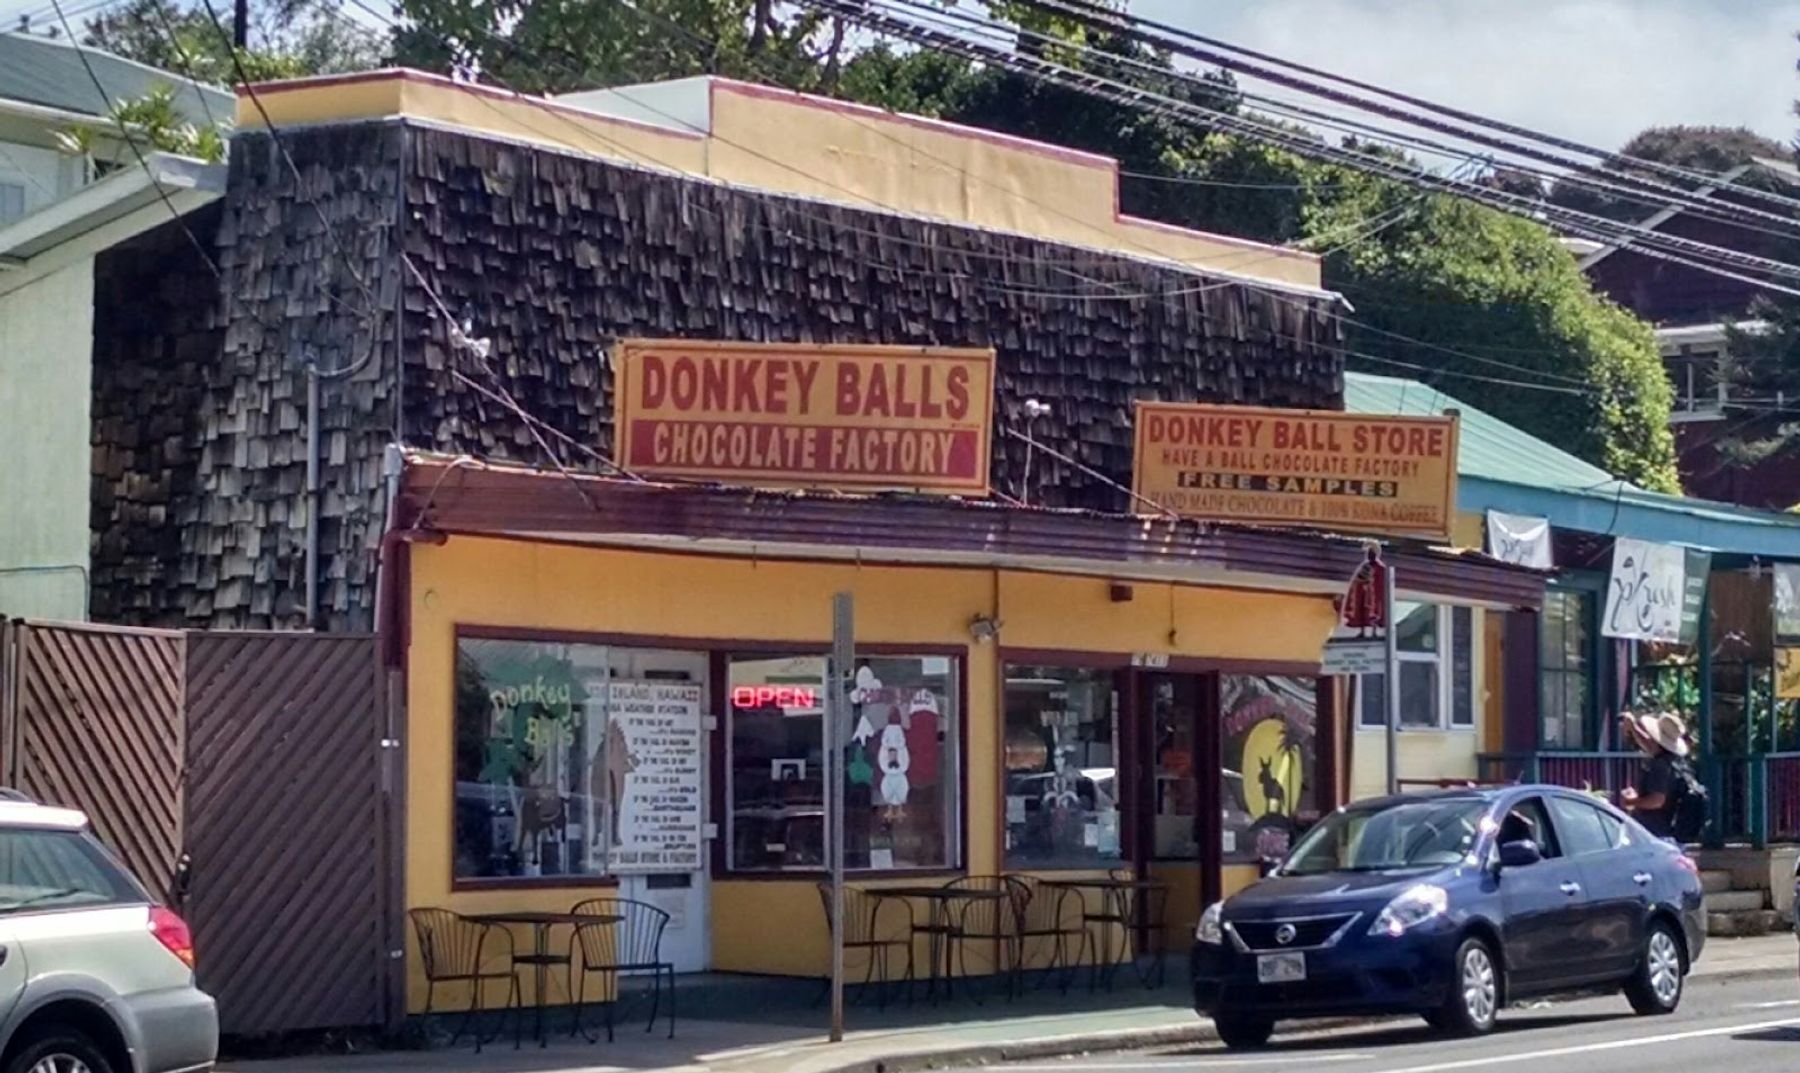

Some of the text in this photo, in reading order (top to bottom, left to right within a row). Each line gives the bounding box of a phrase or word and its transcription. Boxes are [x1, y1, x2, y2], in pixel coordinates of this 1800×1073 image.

[642, 356, 970, 420] DONKEY BALLS
[653, 422, 955, 474] CHOCOLATE FACTORY
[1149, 414, 1443, 456] DONKEY BALL STORE
[1162, 450, 1420, 478] HAVE A BALL CHOCOLATE FACTORY
[1184, 473, 1395, 497] FREE SAMPLES
[1228, 495, 1304, 518] CHOCOLATE
[490, 676, 571, 722] Donkey
[734, 687, 815, 709] OPEN
